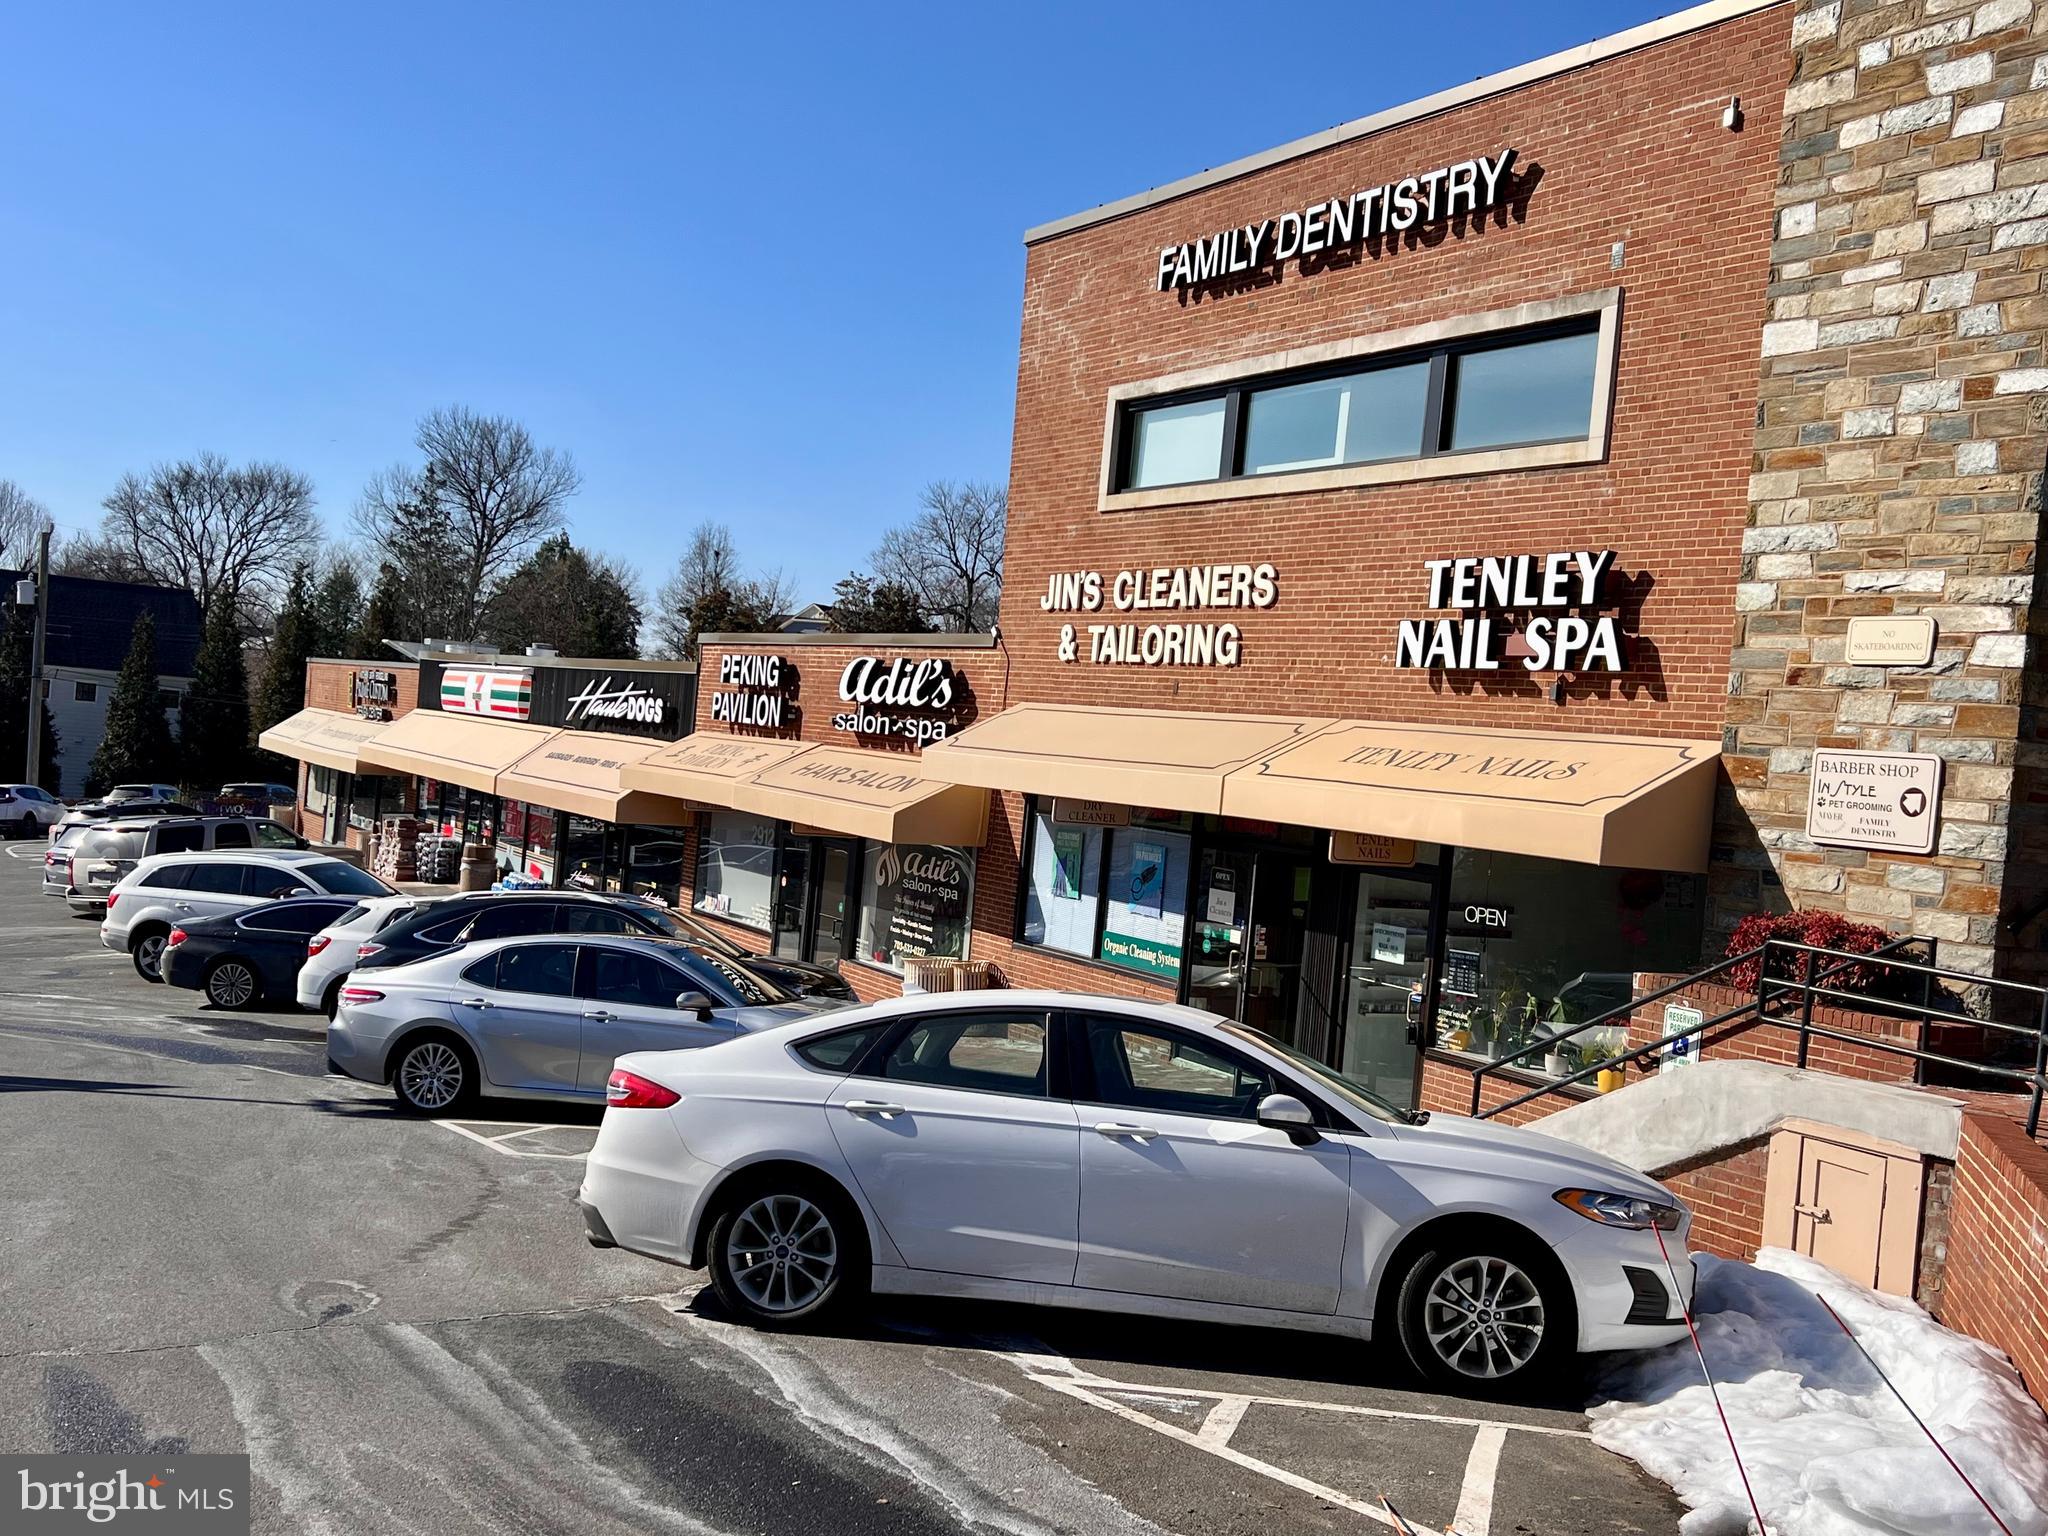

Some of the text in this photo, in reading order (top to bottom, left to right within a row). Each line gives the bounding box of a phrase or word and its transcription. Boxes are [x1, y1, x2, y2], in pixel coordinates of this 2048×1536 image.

[1157, 148, 1514, 292] FAMILY DENTISTRY
[1041, 563, 1279, 613] JIN'S CLEANERS
[1423, 549, 1614, 609] TENLEY
[1396, 617, 1623, 672] NAIL SPA
[1882, 630, 1896, 639] NO
[1058, 623, 1241, 668] & TAILORING
[1853, 642, 1923, 651] SKATEBOARDING
[720, 655, 781, 688] PEKING
[838, 656, 952, 708] Adil's
[712, 691, 782, 728] PAVILION
[834, 704, 947, 748] salon spa
[1340, 746, 1588, 780] TENLEY NAILS
[1820, 760, 1919, 778] BARBER SHOP
[790, 762, 923, 794] HAIR SALON
[1068, 810, 1116, 823] CLEANER
[1083, 801, 1104, 811] DRY
[1819, 811, 1844, 821] MAYER
[1829, 799, 1893, 813] PET GROOMING
[1859, 817, 1890, 827] FAMILY
[751, 825, 775, 845] 2912
[1354, 833, 1395, 847] TENLEY
[1851, 827, 1896, 839] DENTISTRY
[1358, 847, 1391, 859] NAILS
[1215, 870, 1231, 882] OPEN
[902, 877, 958, 902] salon spa
[1464, 905, 1507, 928] OPEN
[1103, 937, 1180, 971] Organic Cleaning System
[1669, 1012, 1698, 1025] RESERVED
